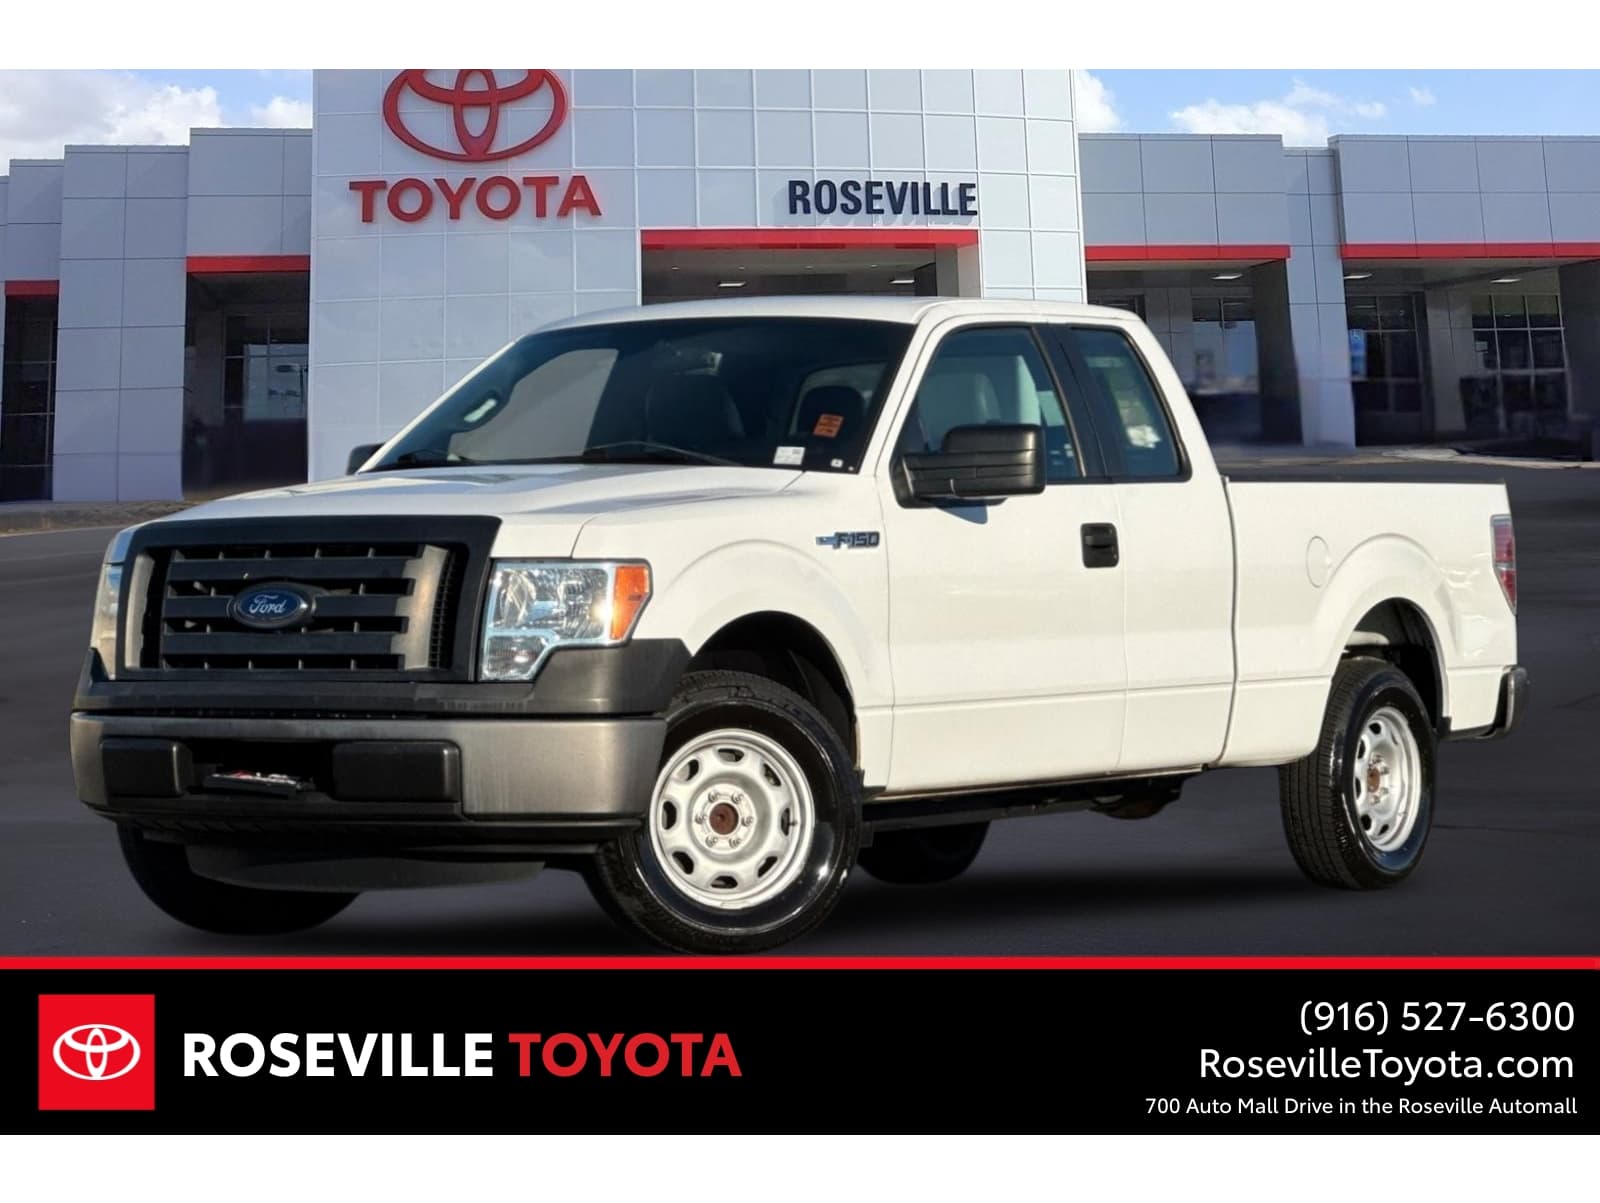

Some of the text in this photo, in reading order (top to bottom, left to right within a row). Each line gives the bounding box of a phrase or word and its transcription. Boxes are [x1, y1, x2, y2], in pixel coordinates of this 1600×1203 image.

[349, 175, 602, 224] TOYOTA
[788, 179, 978, 217] ROSEVILLE
[248, 594, 287, 613] Ford
